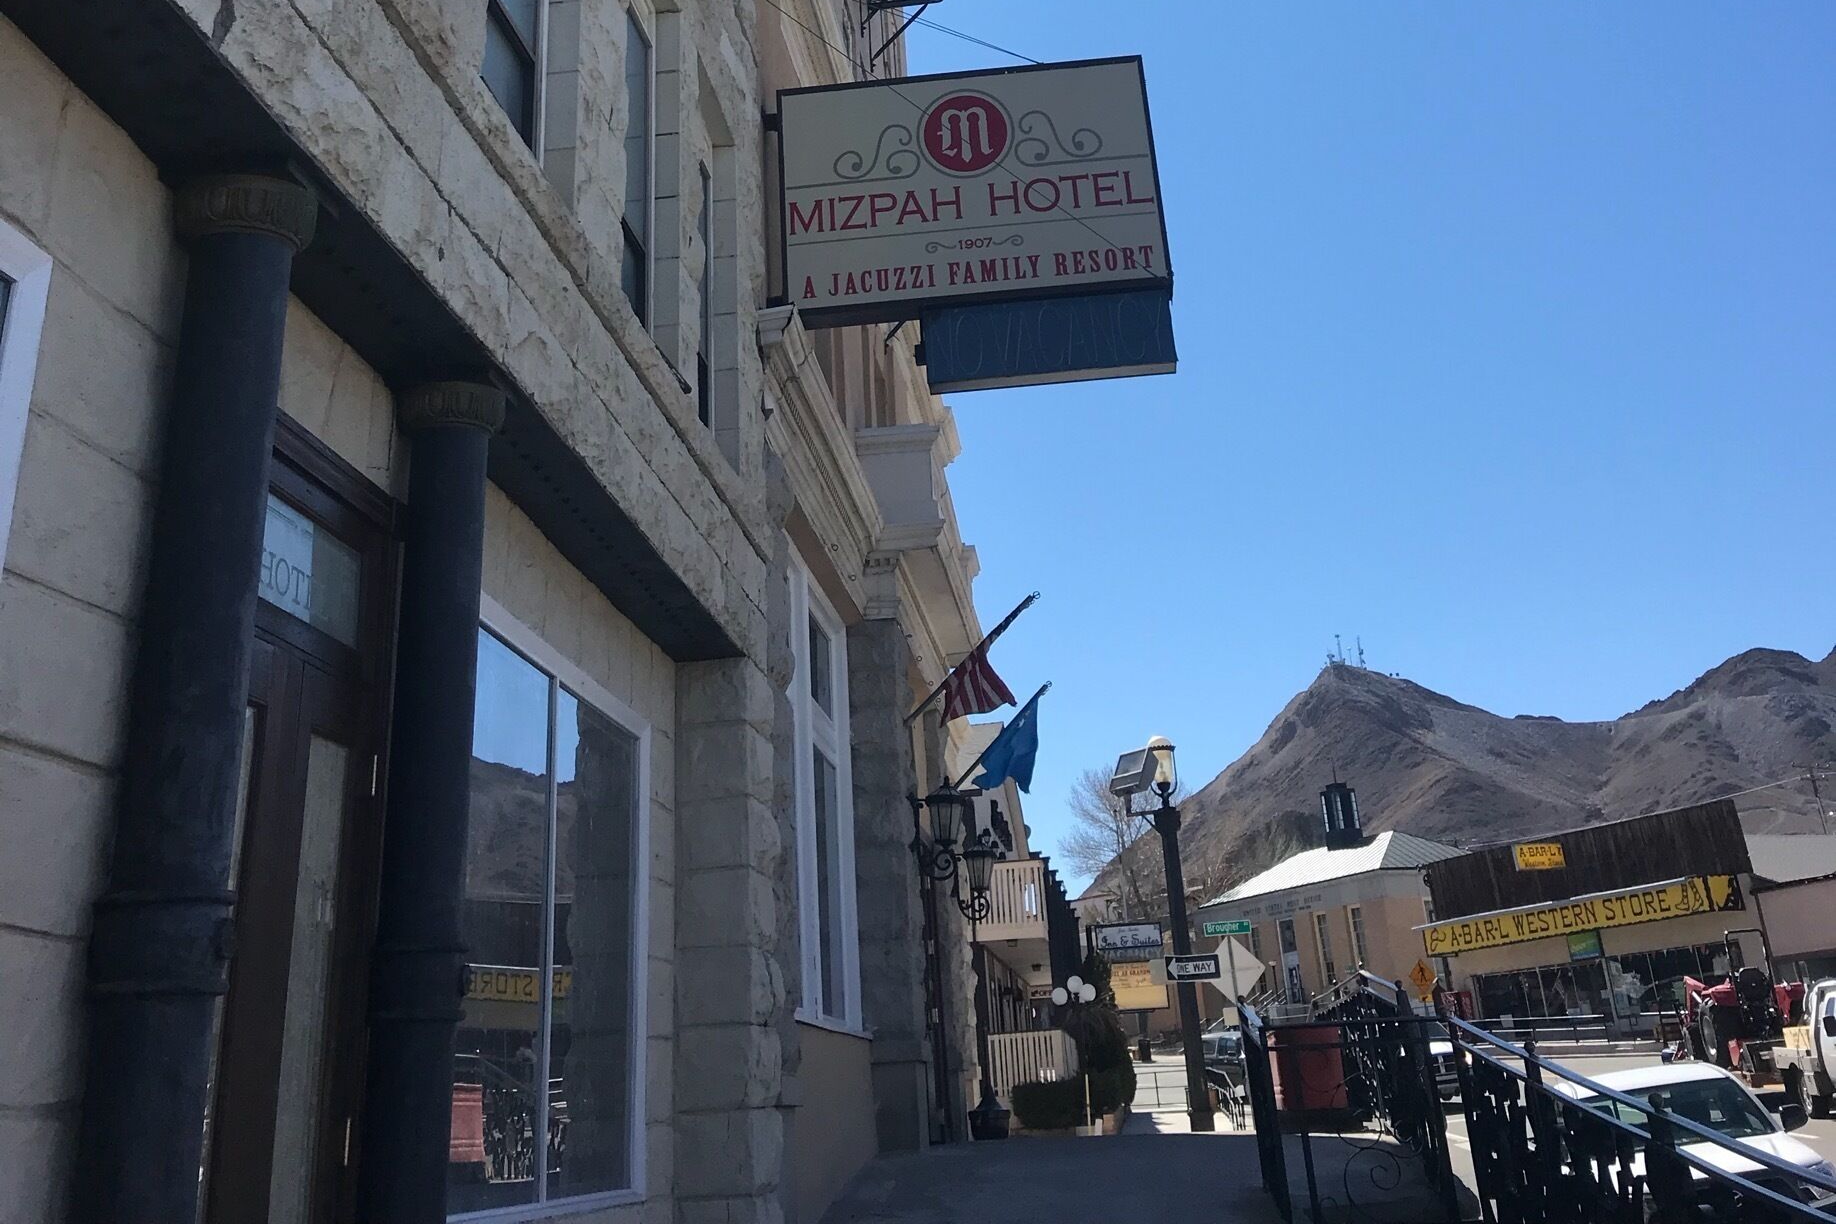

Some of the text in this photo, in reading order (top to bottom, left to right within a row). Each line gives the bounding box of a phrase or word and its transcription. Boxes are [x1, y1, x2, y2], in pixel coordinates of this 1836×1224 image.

[789, 171, 1154, 236] MIZPAH HOTEL
[958, 237, 993, 249] 1907
[803, 246, 1153, 299] A JACUZZI FAMILY RESORT
[1512, 901, 1598, 937] WESTERN
[1602, 889, 1671, 921] STORE
[1120, 936, 1129, 947] &
[1131, 933, 1160, 946] Suites
[1176, 961, 1212, 974] ONE WAY
